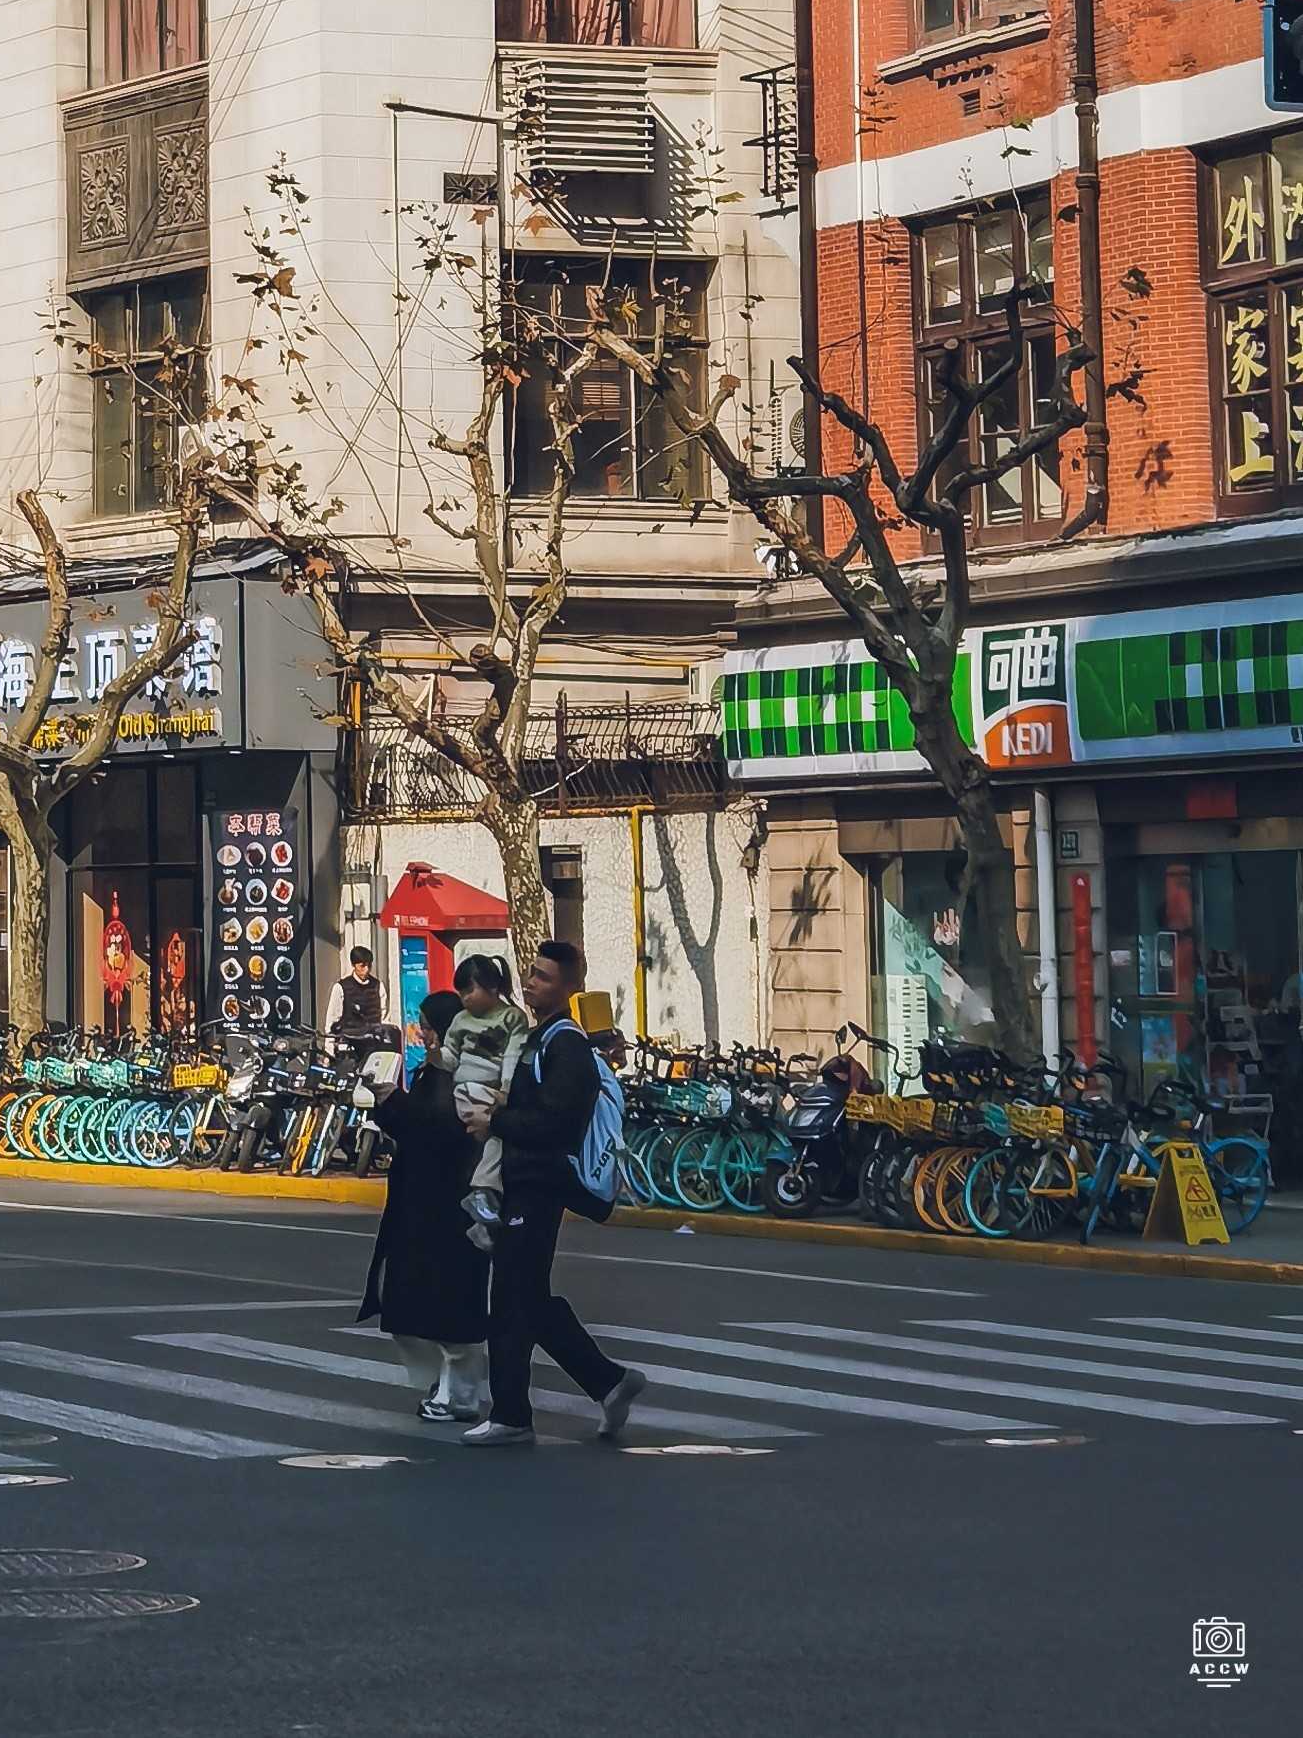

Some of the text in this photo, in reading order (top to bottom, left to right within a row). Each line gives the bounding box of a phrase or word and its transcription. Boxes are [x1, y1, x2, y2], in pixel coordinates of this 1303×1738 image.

[118, 712, 142, 738] Old
[144, 708, 215, 737] Shanghai
[1002, 722, 1052, 757] KEDI
